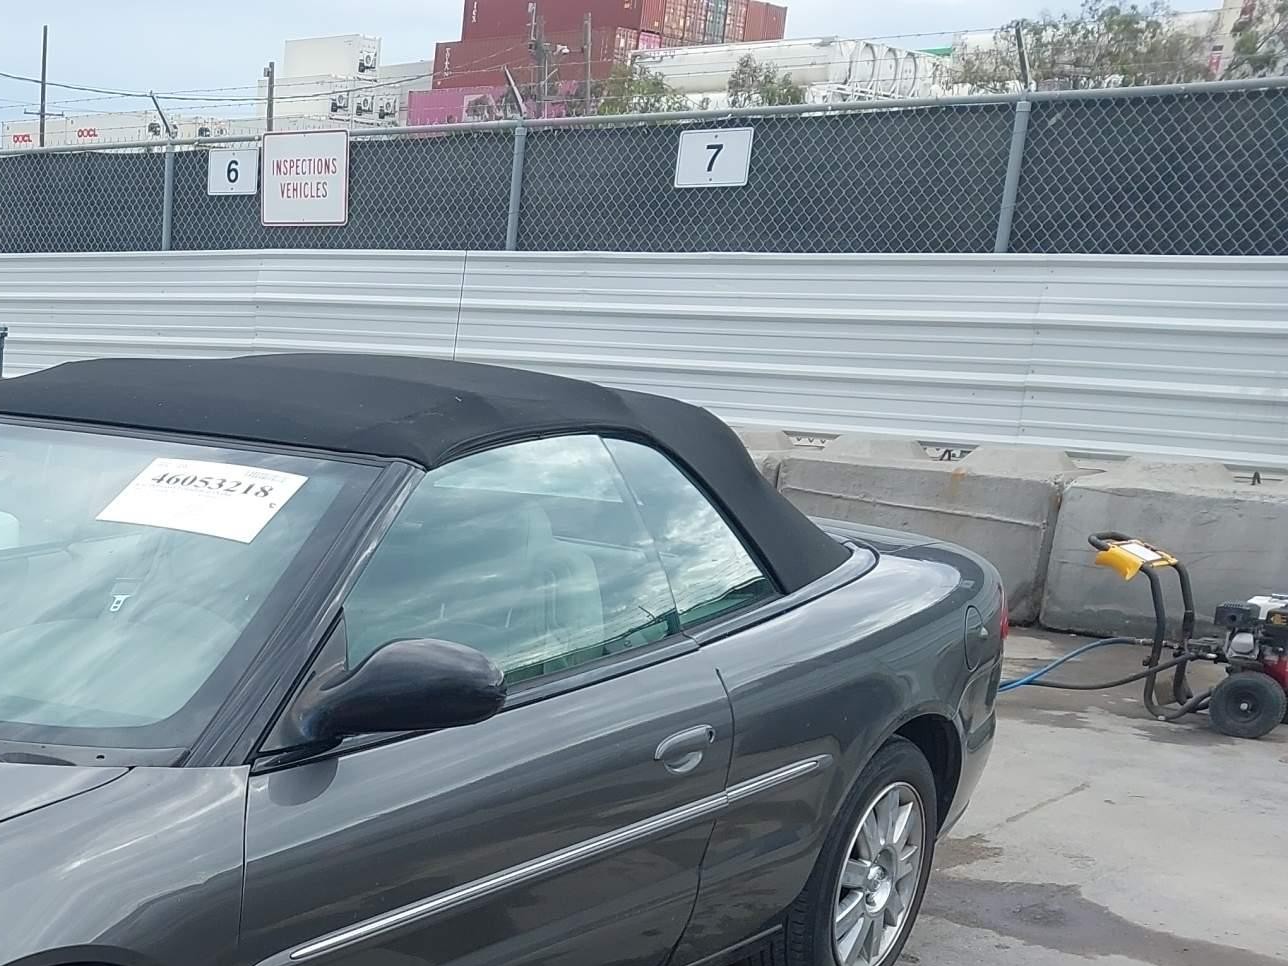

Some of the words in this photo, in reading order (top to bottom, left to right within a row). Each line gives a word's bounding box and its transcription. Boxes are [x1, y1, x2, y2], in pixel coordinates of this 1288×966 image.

[13, 134, 32, 143] OOCL
[77, 128, 98, 138] OOCL
[272, 158, 337, 176] INSPECTIONS
[706, 144, 724, 172] 7
[226, 160, 239, 183] 6
[280, 182, 328, 198] VEHICLES
[151, 472, 274, 498] 46053218
